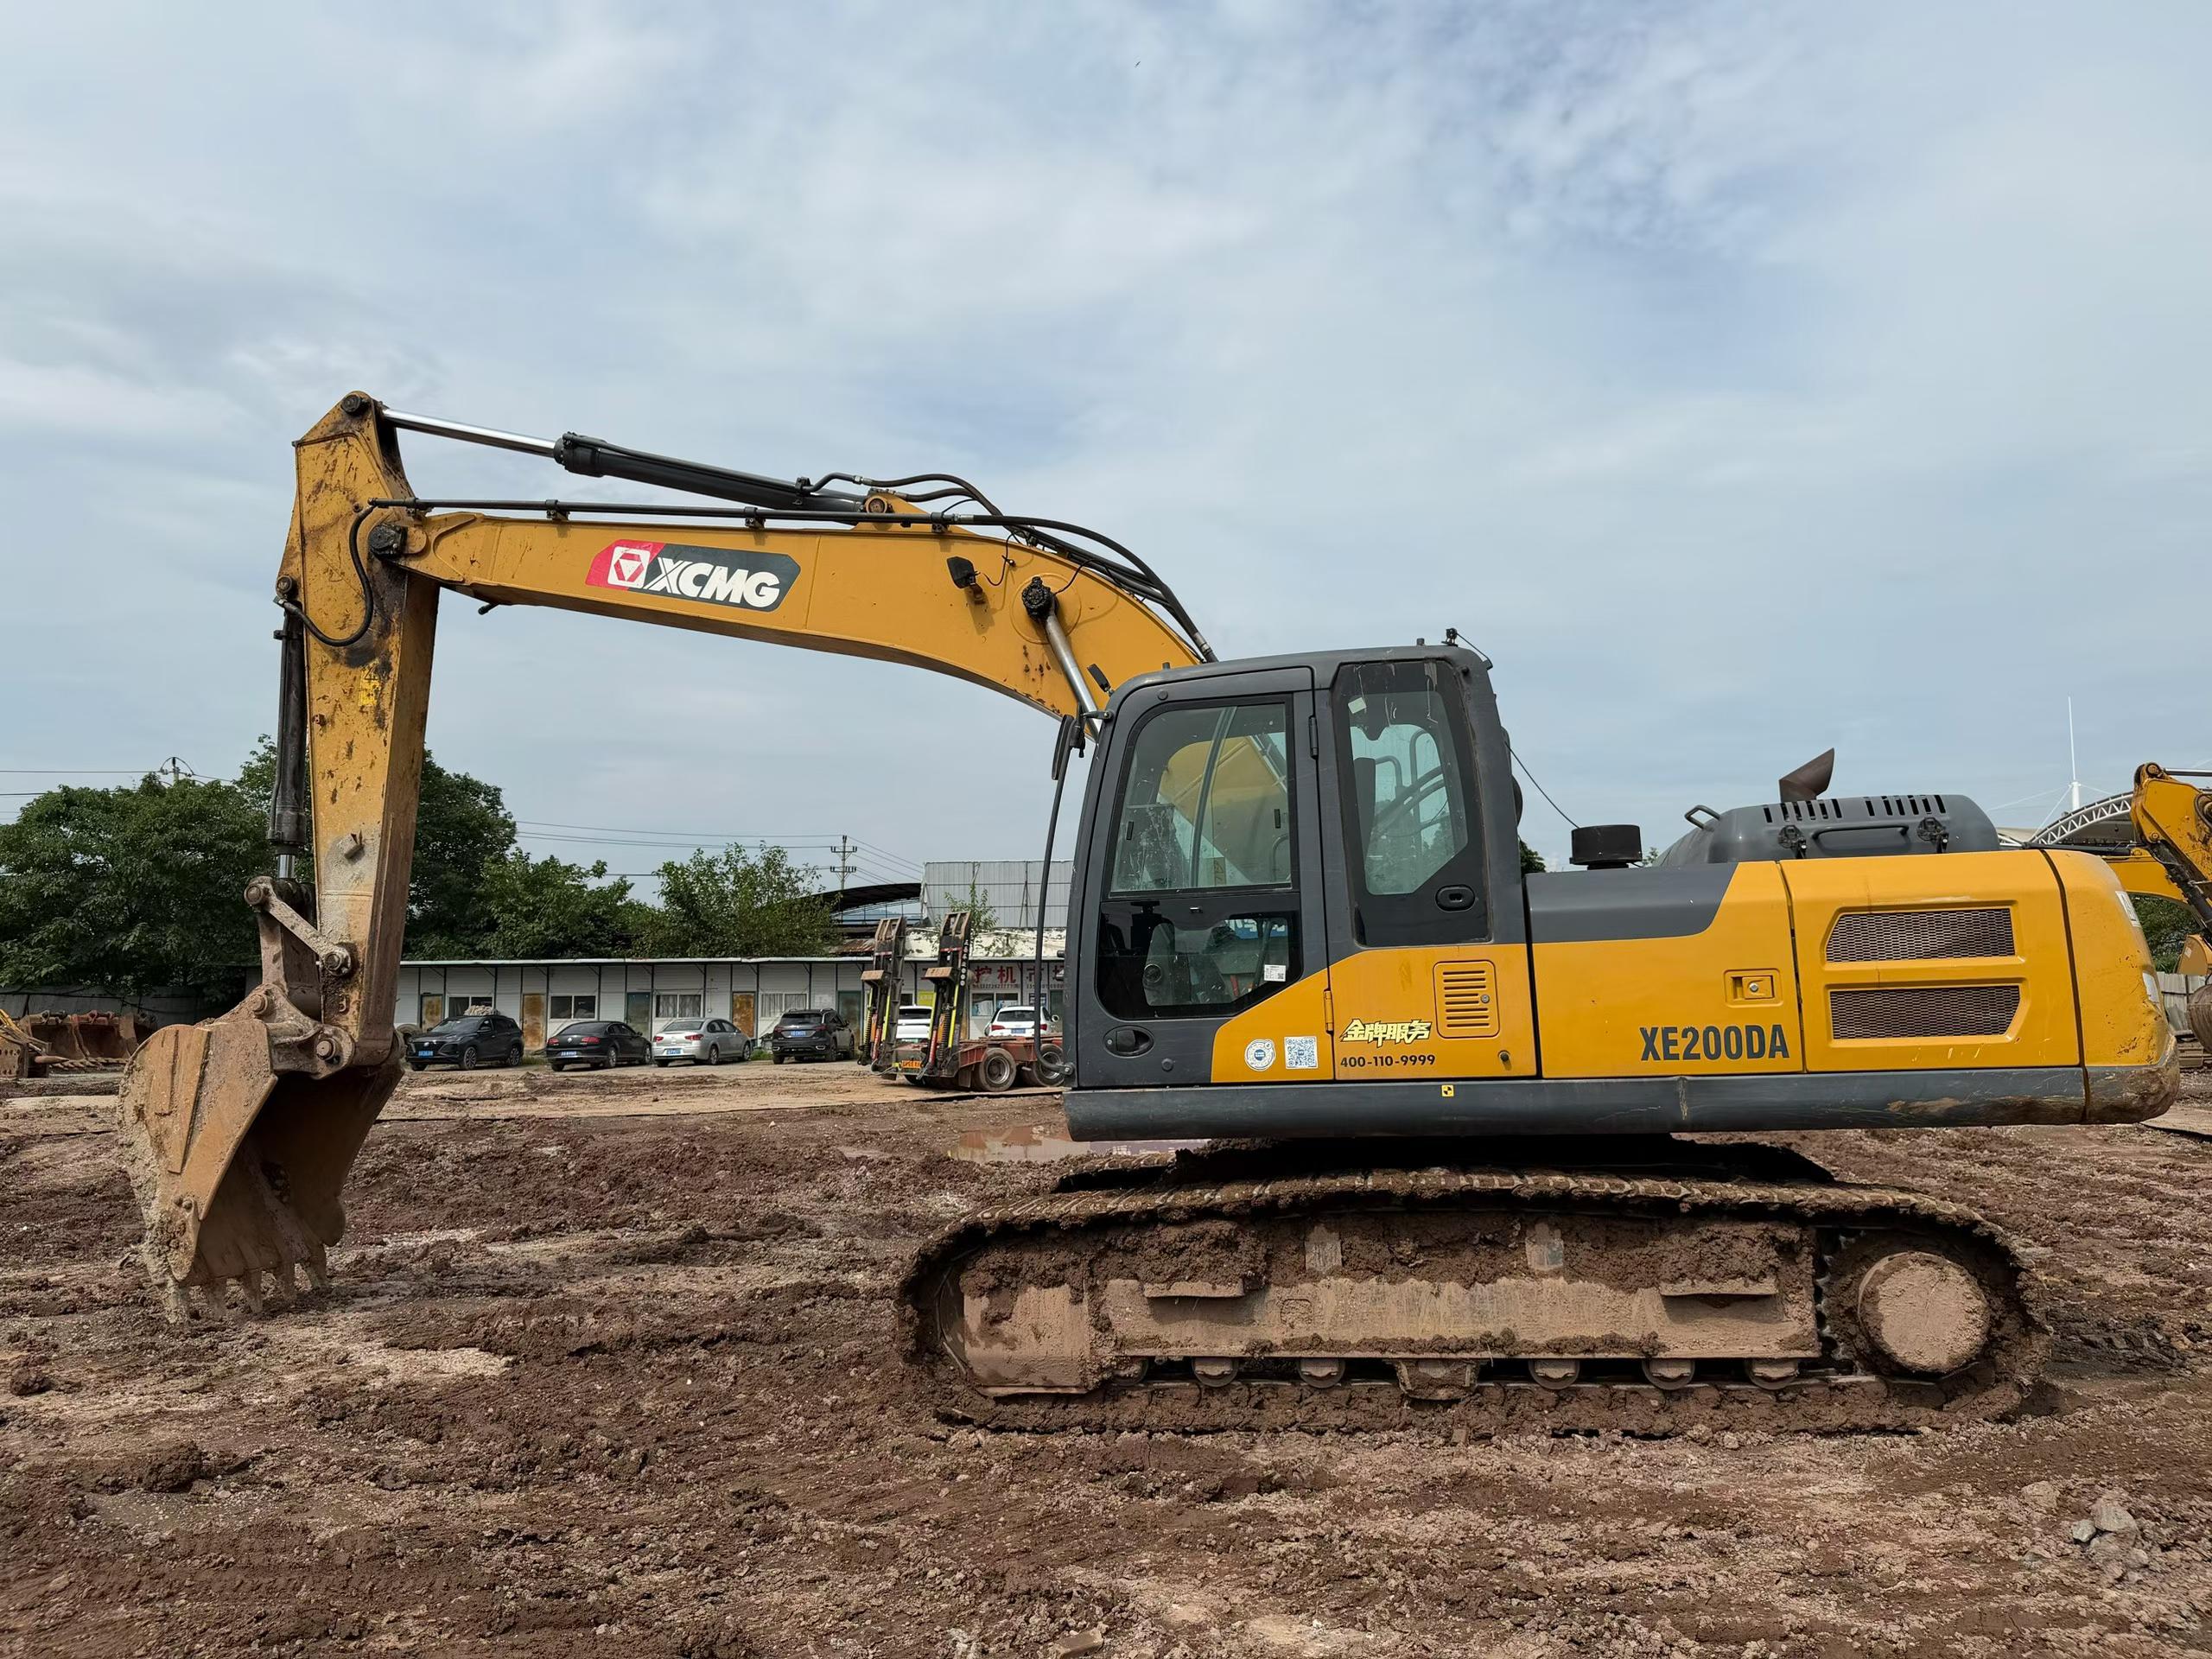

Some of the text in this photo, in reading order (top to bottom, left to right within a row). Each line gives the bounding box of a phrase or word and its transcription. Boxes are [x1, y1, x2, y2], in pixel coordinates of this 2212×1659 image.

[643, 557, 779, 607] XCMG
[1340, 1019, 1432, 1048] 金牌服务
[1639, 1024, 1790, 1061] XE200DA
[1340, 1054, 1435, 1067] 400-110-9999
